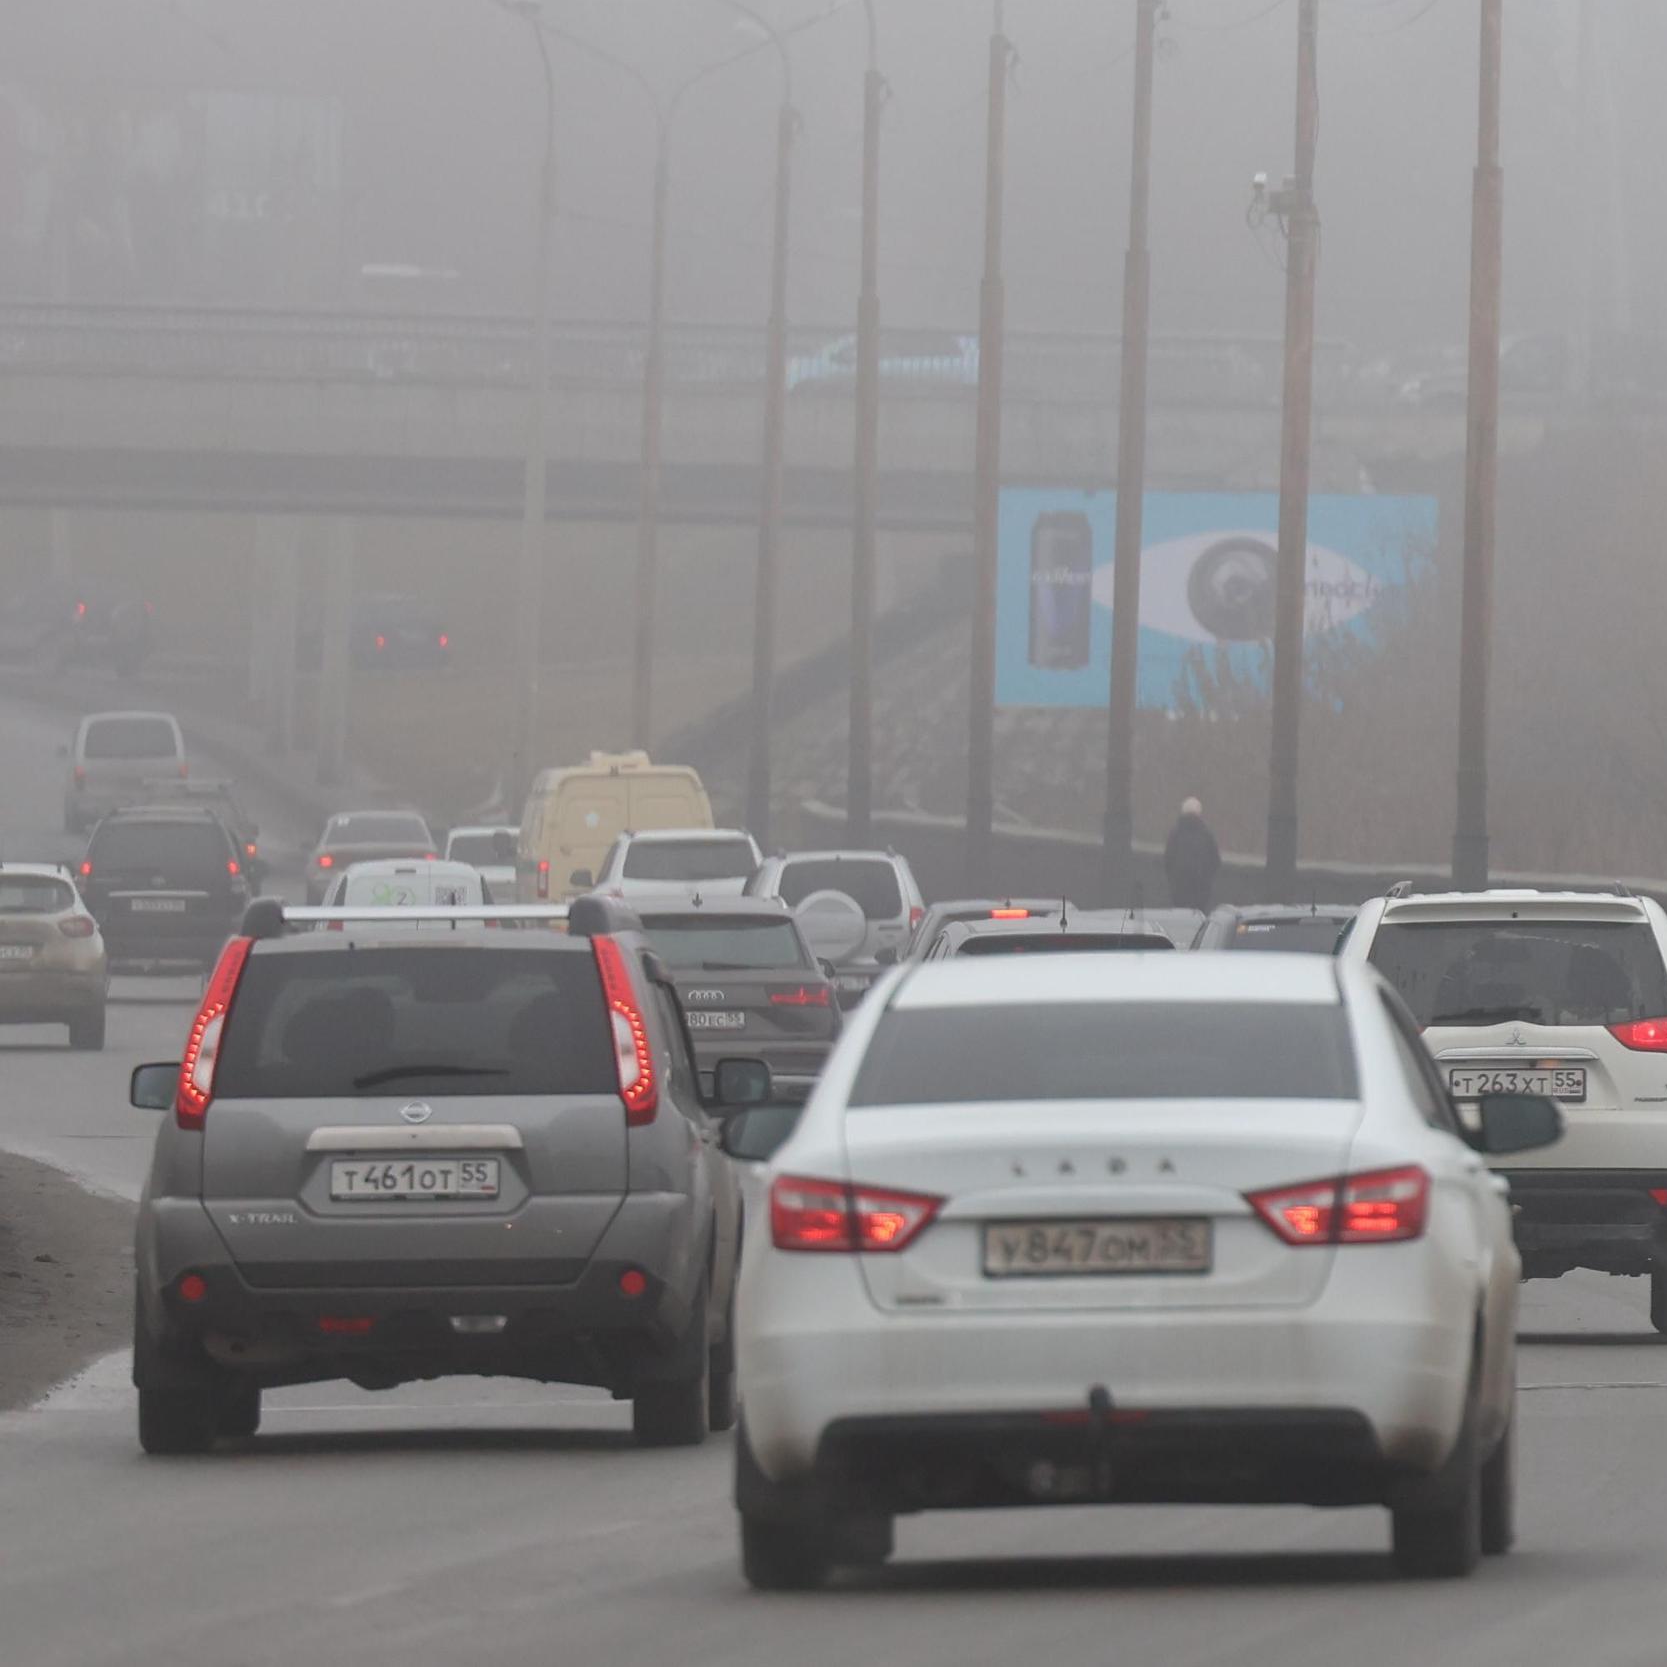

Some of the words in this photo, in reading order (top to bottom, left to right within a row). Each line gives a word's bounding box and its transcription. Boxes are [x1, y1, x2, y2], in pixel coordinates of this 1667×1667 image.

[1555, 1072, 1576, 1088] 55
[461, 1163, 488, 1182] 55
[1011, 1156, 1175, 1176] LADA
